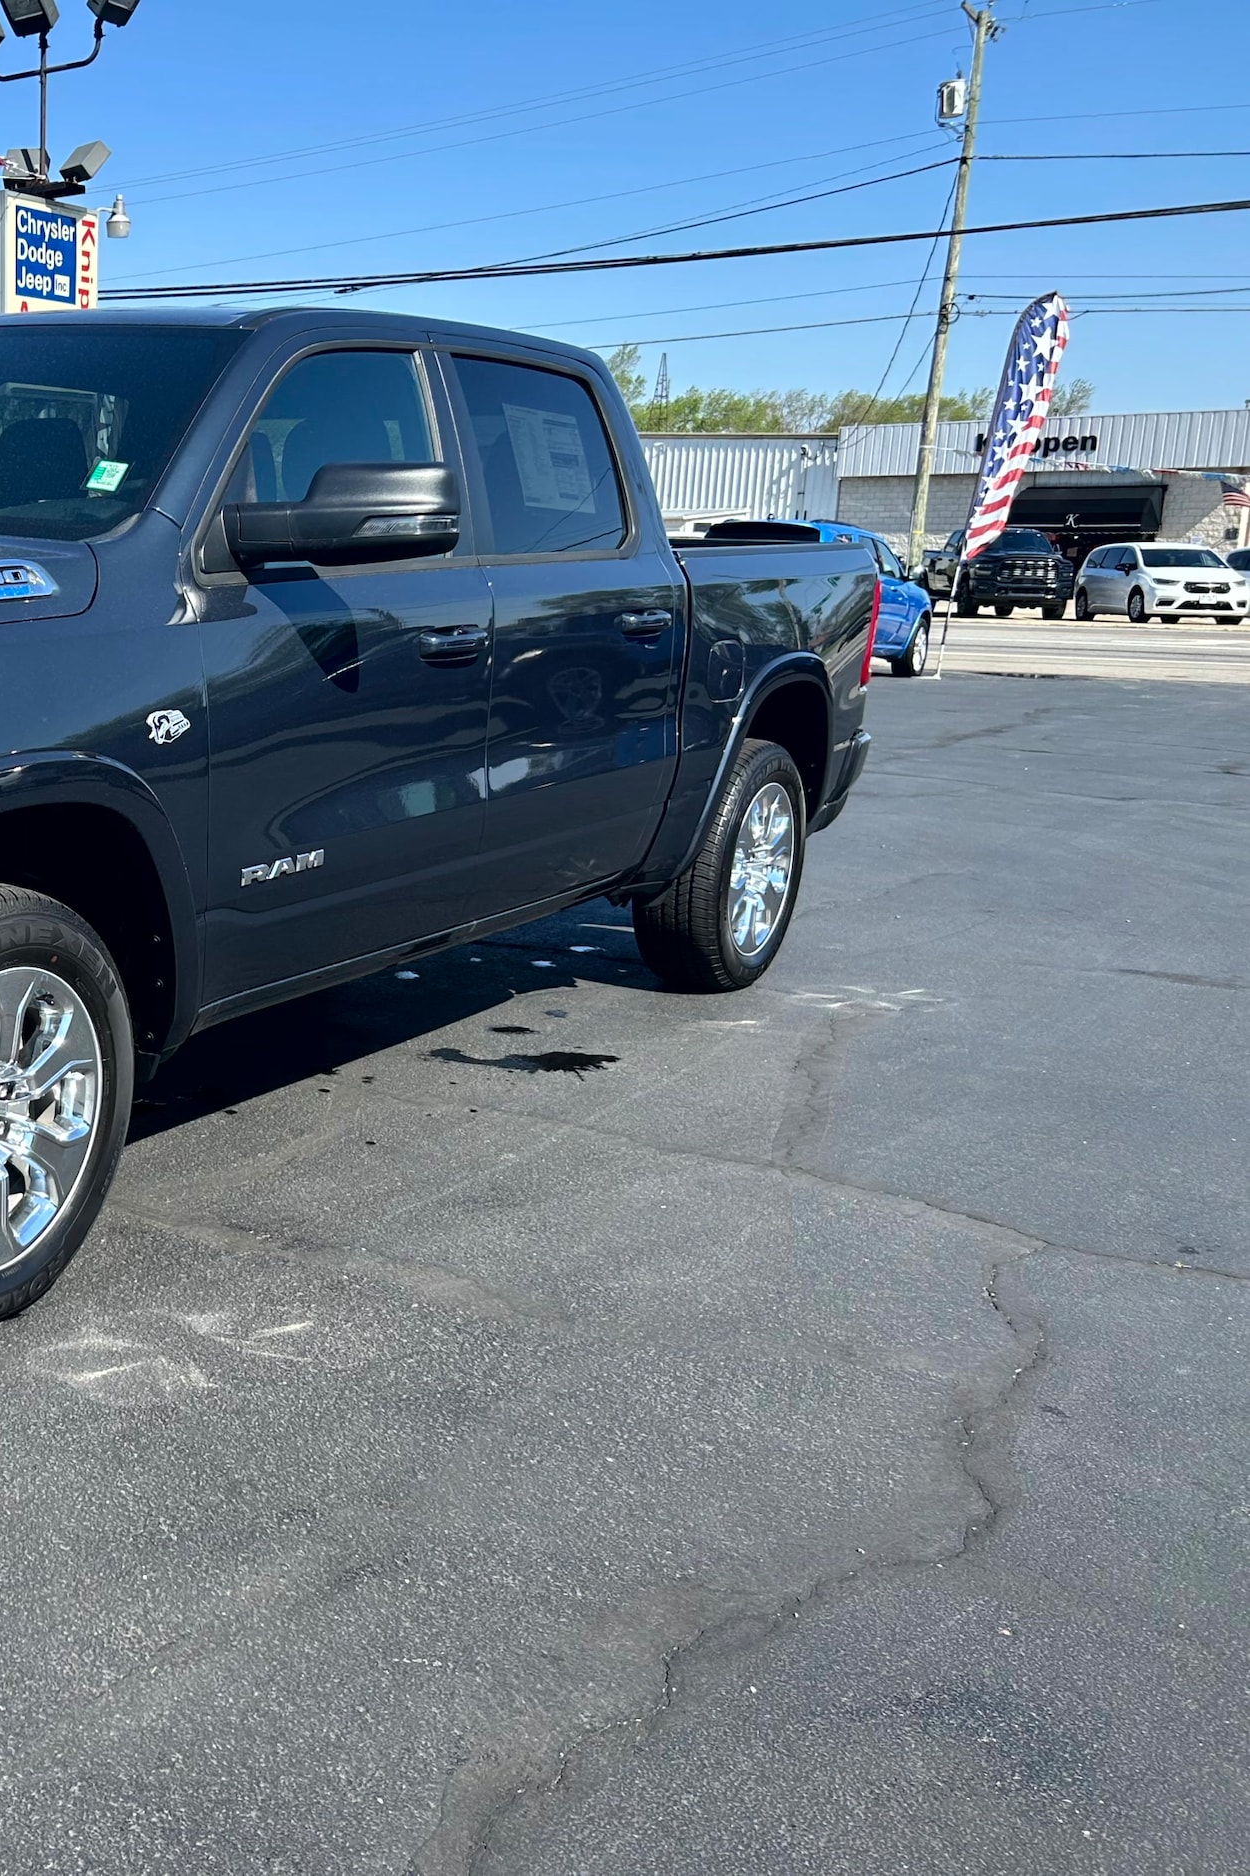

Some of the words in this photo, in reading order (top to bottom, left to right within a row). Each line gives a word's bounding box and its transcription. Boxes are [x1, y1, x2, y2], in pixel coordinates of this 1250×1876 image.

[17, 210, 76, 242] Chrysler
[17, 238, 63, 270] Dodge
[17, 266, 52, 296] Jeep
[975, 433, 1098, 458] Kpen
[1064, 513, 1080, 529] K
[239, 848, 325, 887] RAM
[0, 922, 118, 998] NEXEN
